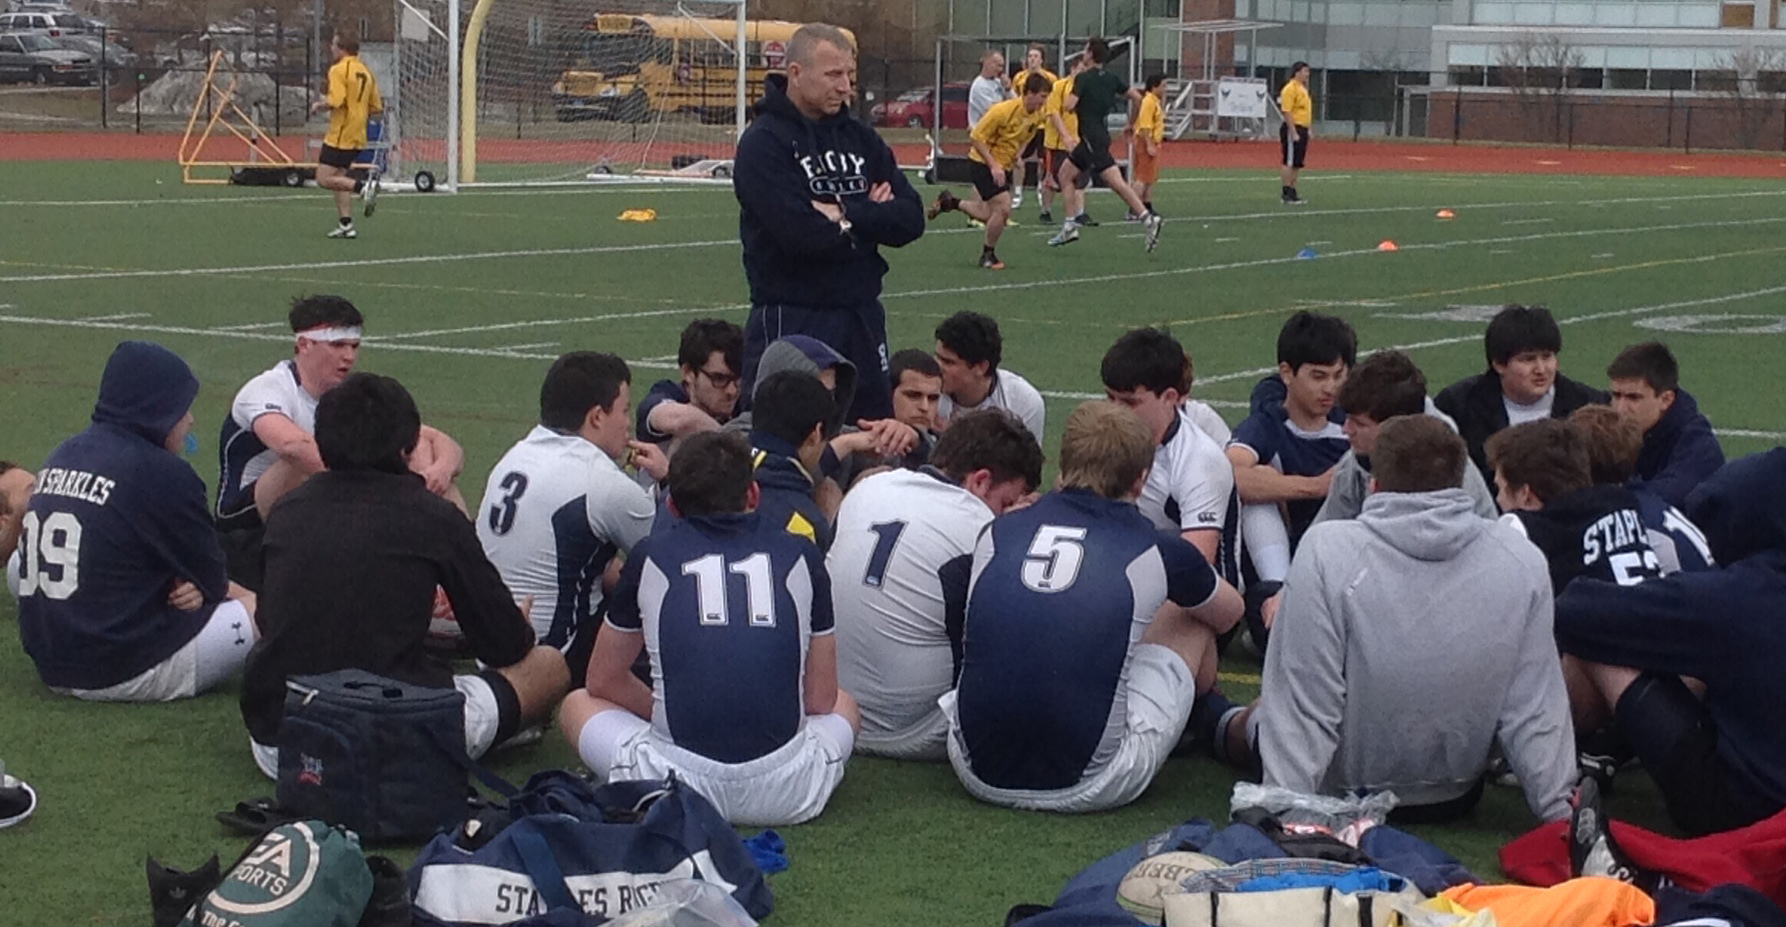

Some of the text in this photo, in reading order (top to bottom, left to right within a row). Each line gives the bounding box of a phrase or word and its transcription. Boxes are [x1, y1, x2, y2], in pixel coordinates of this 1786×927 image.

[356, 72, 368, 103] 7
[489, 471, 528, 536] 3
[863, 518, 909, 590] 1
[1021, 525, 1087, 593] 5
[1583, 509, 1650, 566] STAPL
[1663, 505, 1715, 567] 1
[682, 553, 776, 627] 11
[229, 865, 288, 896] PORTS
[496, 883, 609, 917] STAES
[1124, 862, 1197, 882] BER
